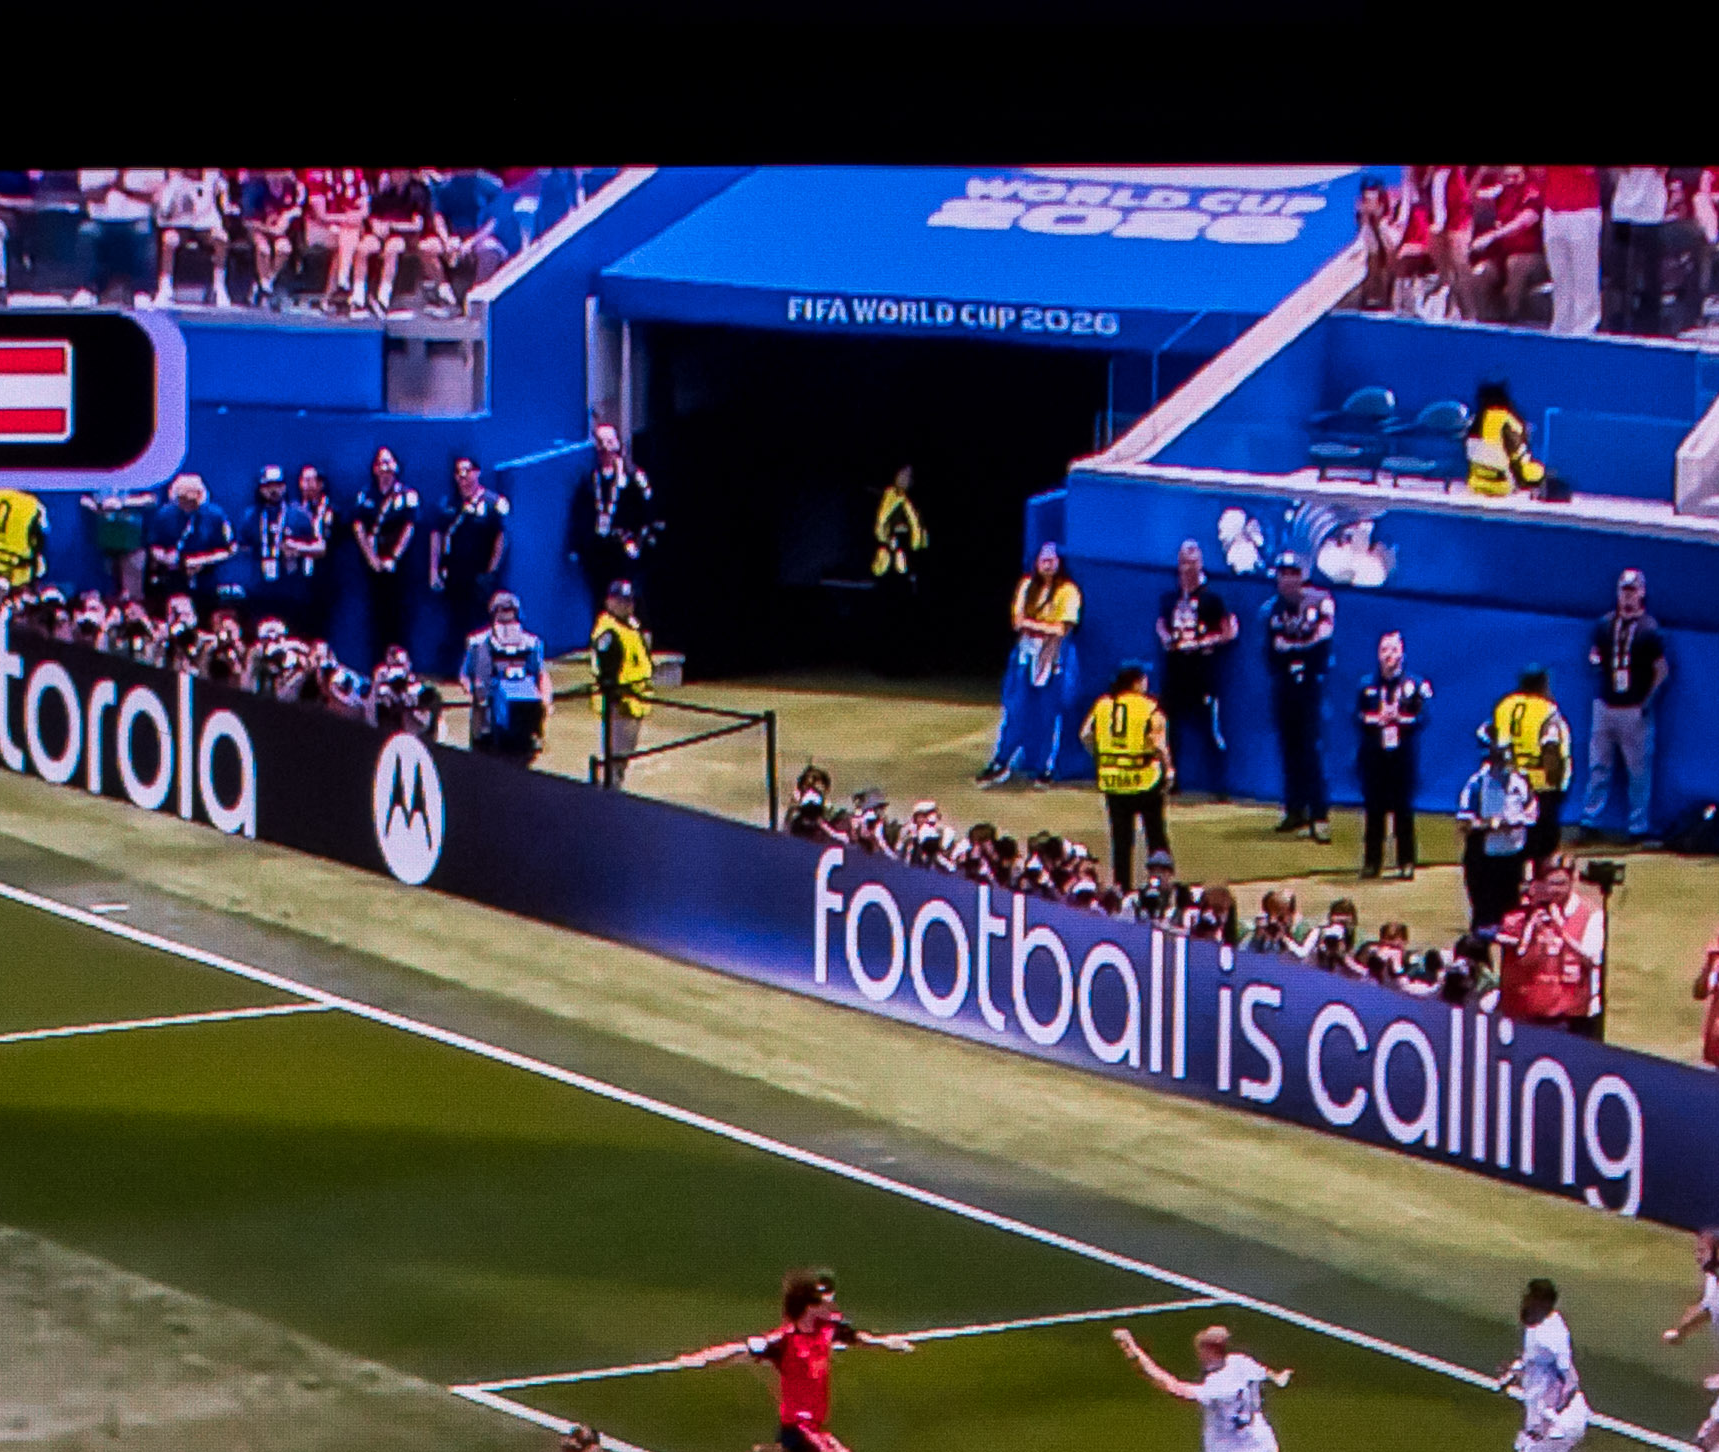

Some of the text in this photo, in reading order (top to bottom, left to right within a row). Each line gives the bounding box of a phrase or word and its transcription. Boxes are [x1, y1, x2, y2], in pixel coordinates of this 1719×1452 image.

[966, 177, 1328, 215] WORLD CUP
[787, 295, 849, 324] FIFA
[851, 297, 955, 326] WORLD
[959, 303, 1016, 331] CUP
[813, 846, 1645, 1219] football is calling
